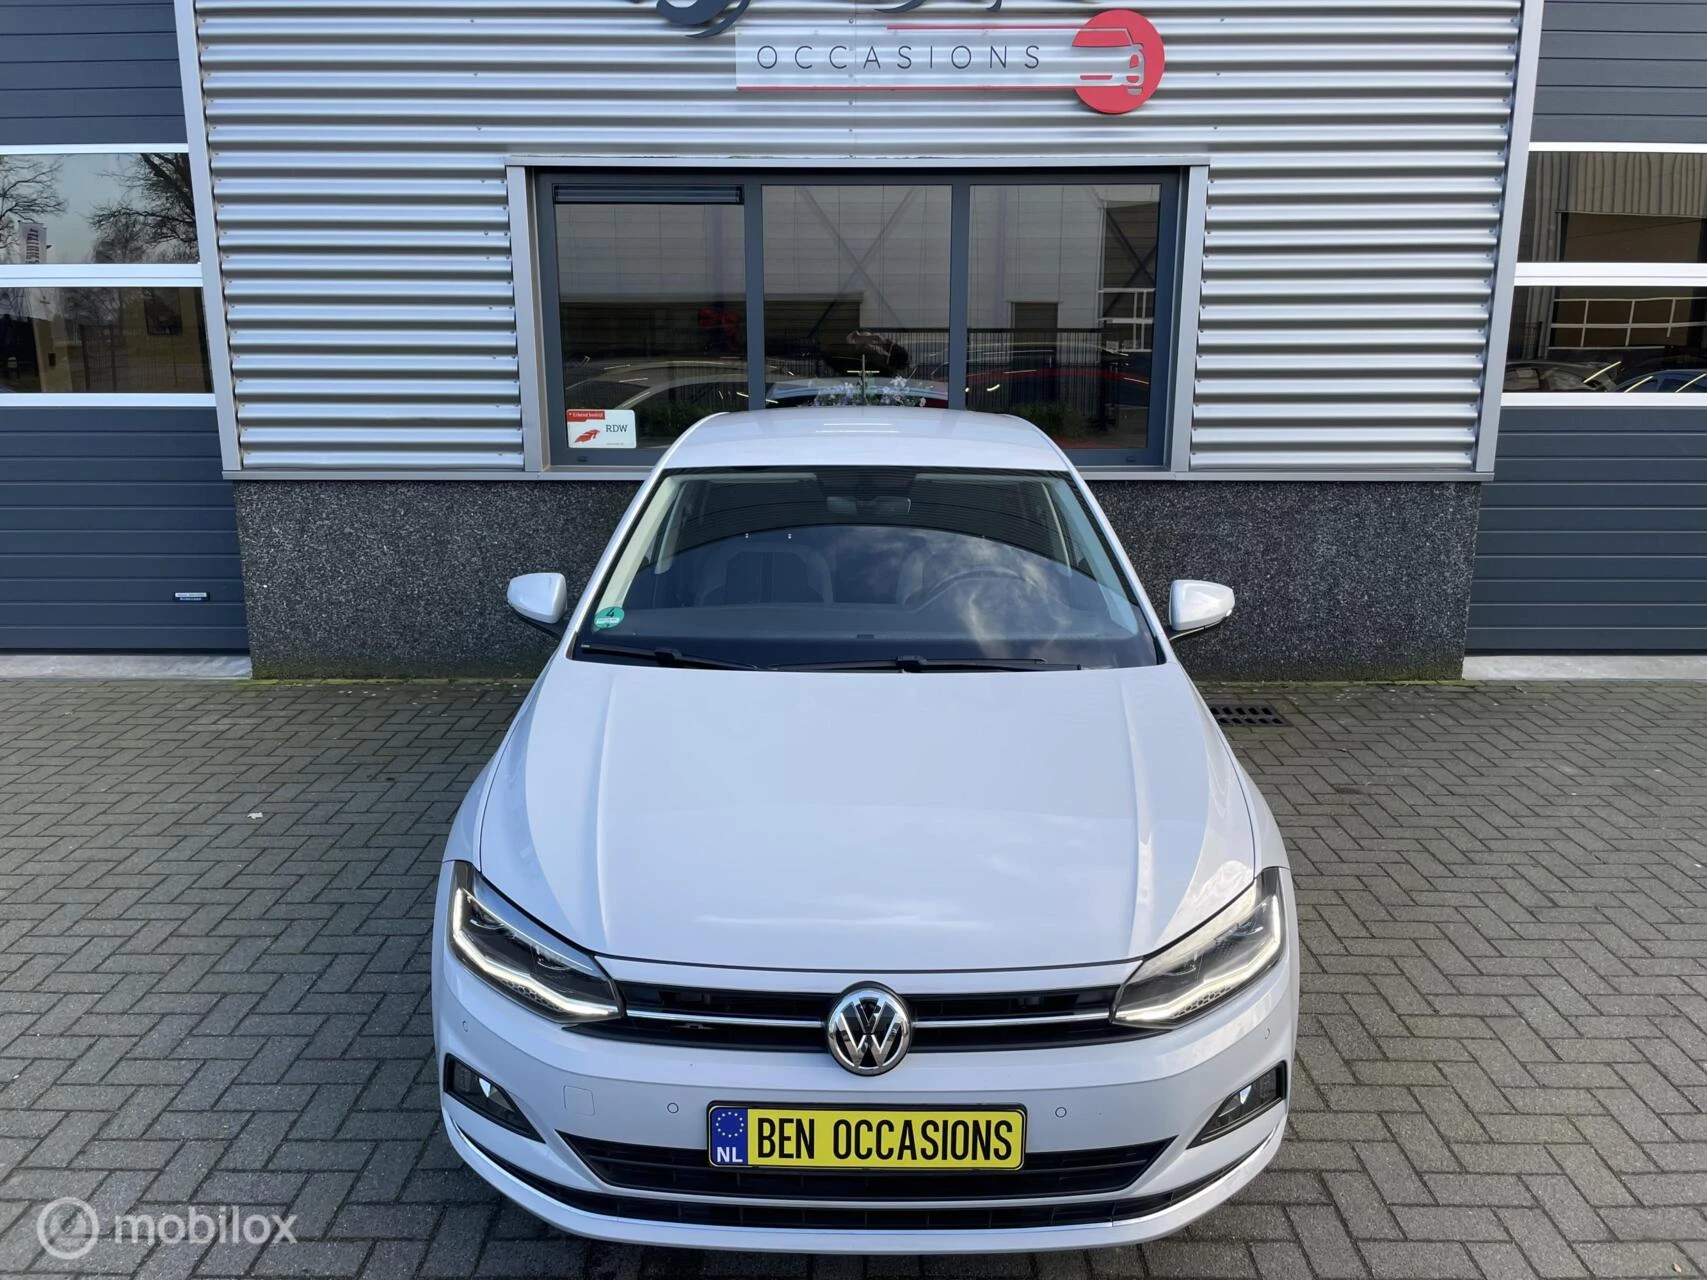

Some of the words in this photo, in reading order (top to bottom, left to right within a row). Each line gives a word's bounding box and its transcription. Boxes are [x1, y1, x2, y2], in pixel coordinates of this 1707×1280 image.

[756, 44, 1042, 70] OCCASIONS
[605, 424, 628, 433] RDW
[606, 607, 615, 617] 4
[757, 1117, 815, 1160] BEN
[833, 1119, 1013, 1161] OCCASIONS
[716, 1146, 743, 1163] NL
